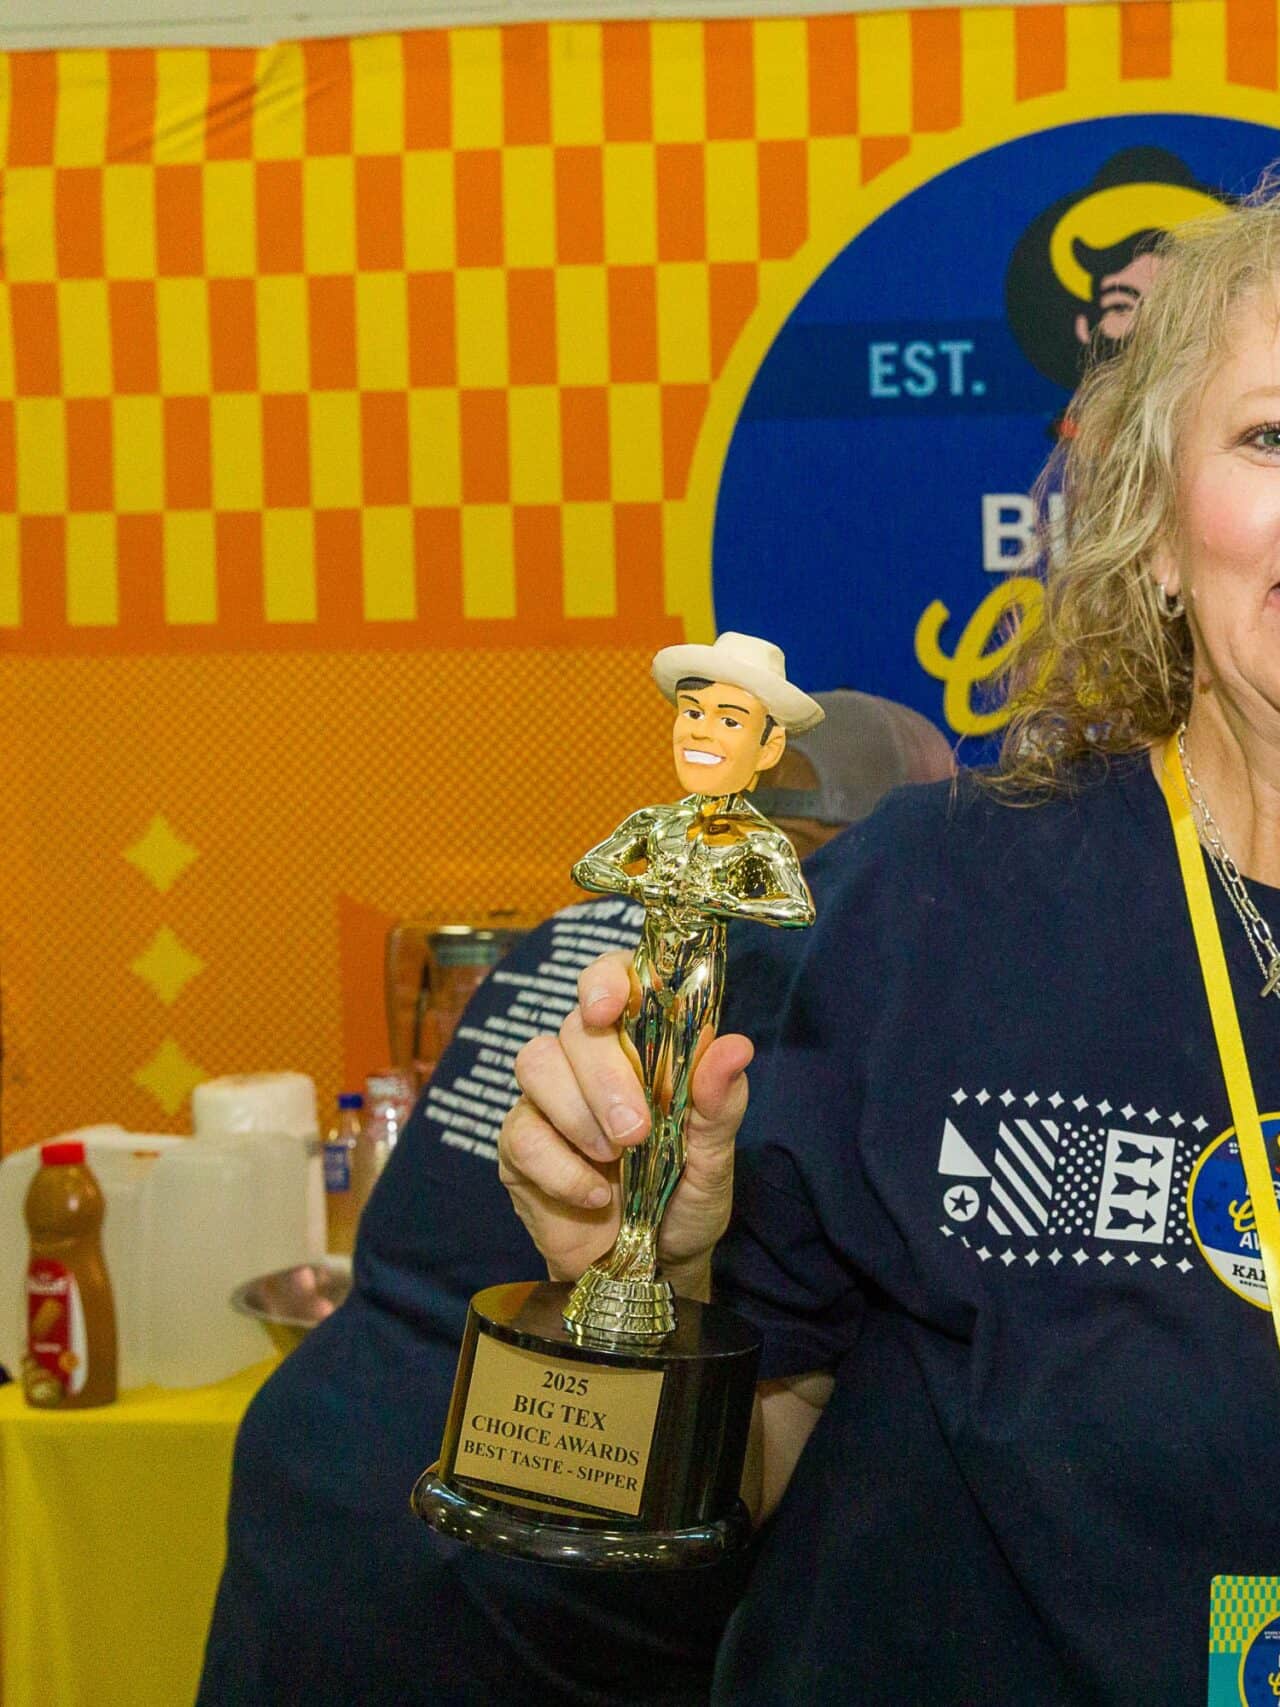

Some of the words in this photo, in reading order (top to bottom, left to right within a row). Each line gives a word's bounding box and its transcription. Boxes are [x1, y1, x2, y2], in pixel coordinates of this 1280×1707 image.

[868, 341, 987, 398] EST.
[981, 493, 1075, 572] BI
[541, 1370, 589, 1396] 2025
[512, 1394, 555, 1420] BIG
[561, 1404, 607, 1431] TEX
[463, 1439, 508, 1461] BEST
[510, 1449, 564, 1476] TASTE
[576, 1466, 639, 1492] SIPPER
[471, 1414, 551, 1446] CHOICE
[554, 1432, 640, 1466] AWARDS
